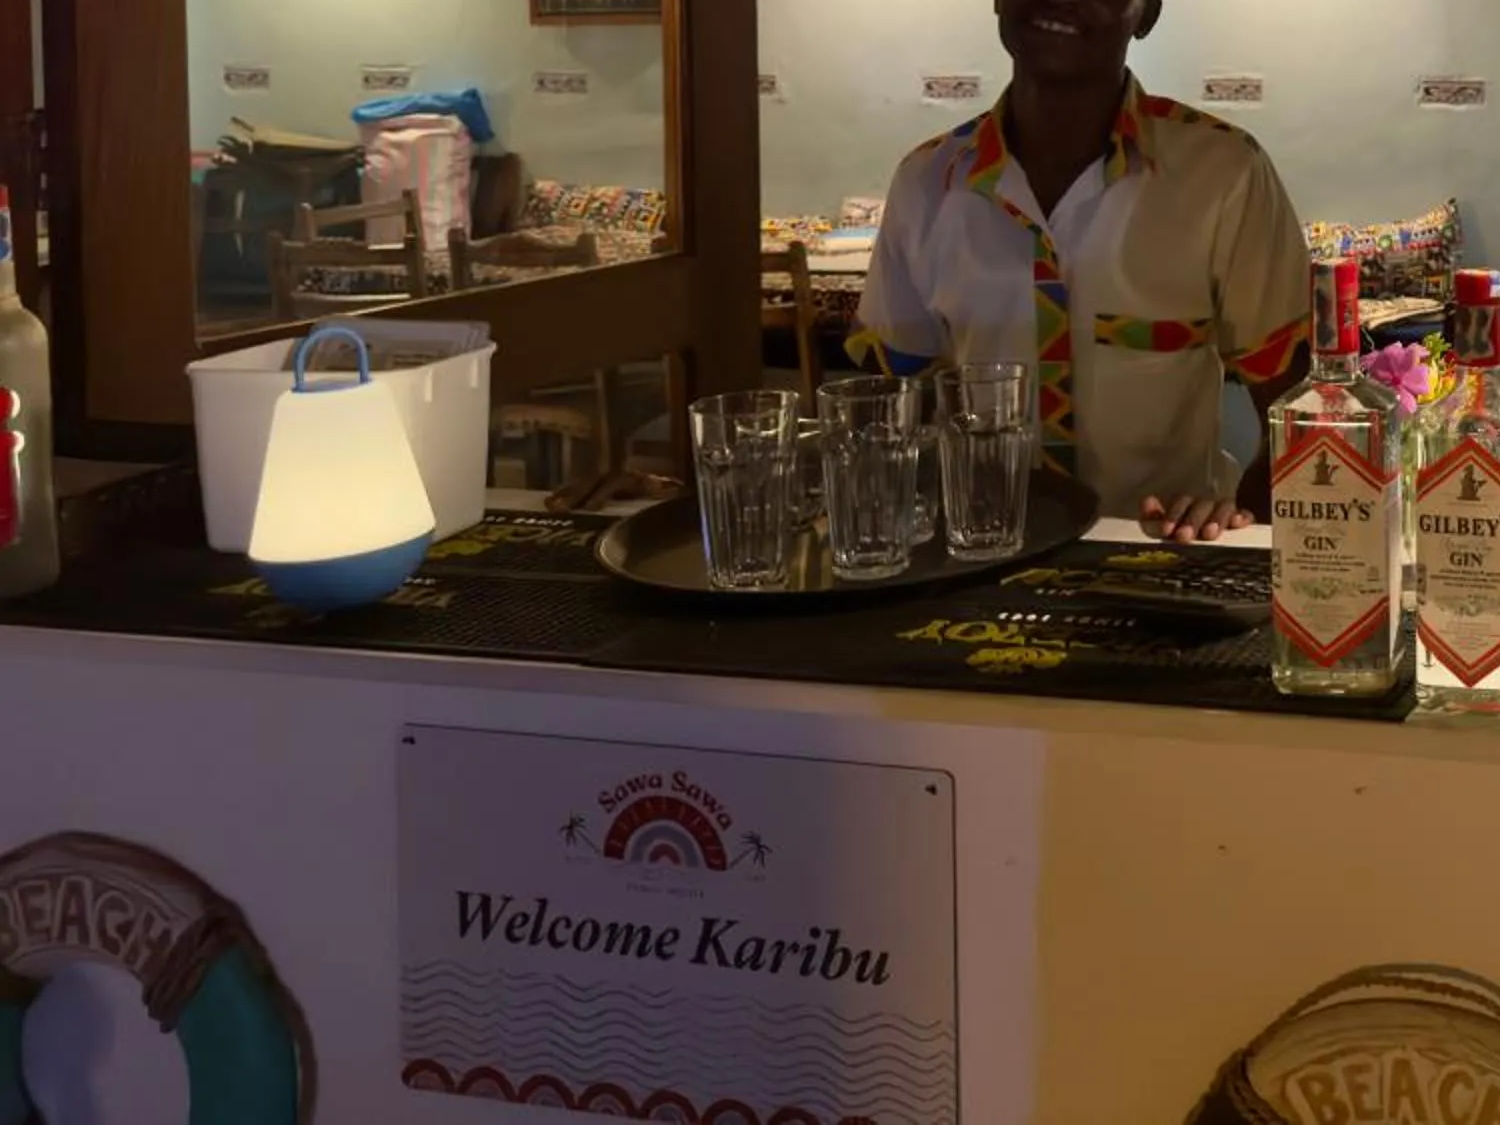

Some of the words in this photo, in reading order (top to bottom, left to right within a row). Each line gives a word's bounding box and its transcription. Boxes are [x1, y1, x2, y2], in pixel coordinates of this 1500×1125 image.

[1275, 499, 1372, 522] GILBEY'S
[1304, 536, 1338, 550] GIN
[1450, 551, 1484, 567] GIN
[598, 773, 662, 813] Sawa
[671, 770, 733, 831] Sawa
[454, 891, 680, 961] Welcome
[689, 916, 892, 986] Karibu
